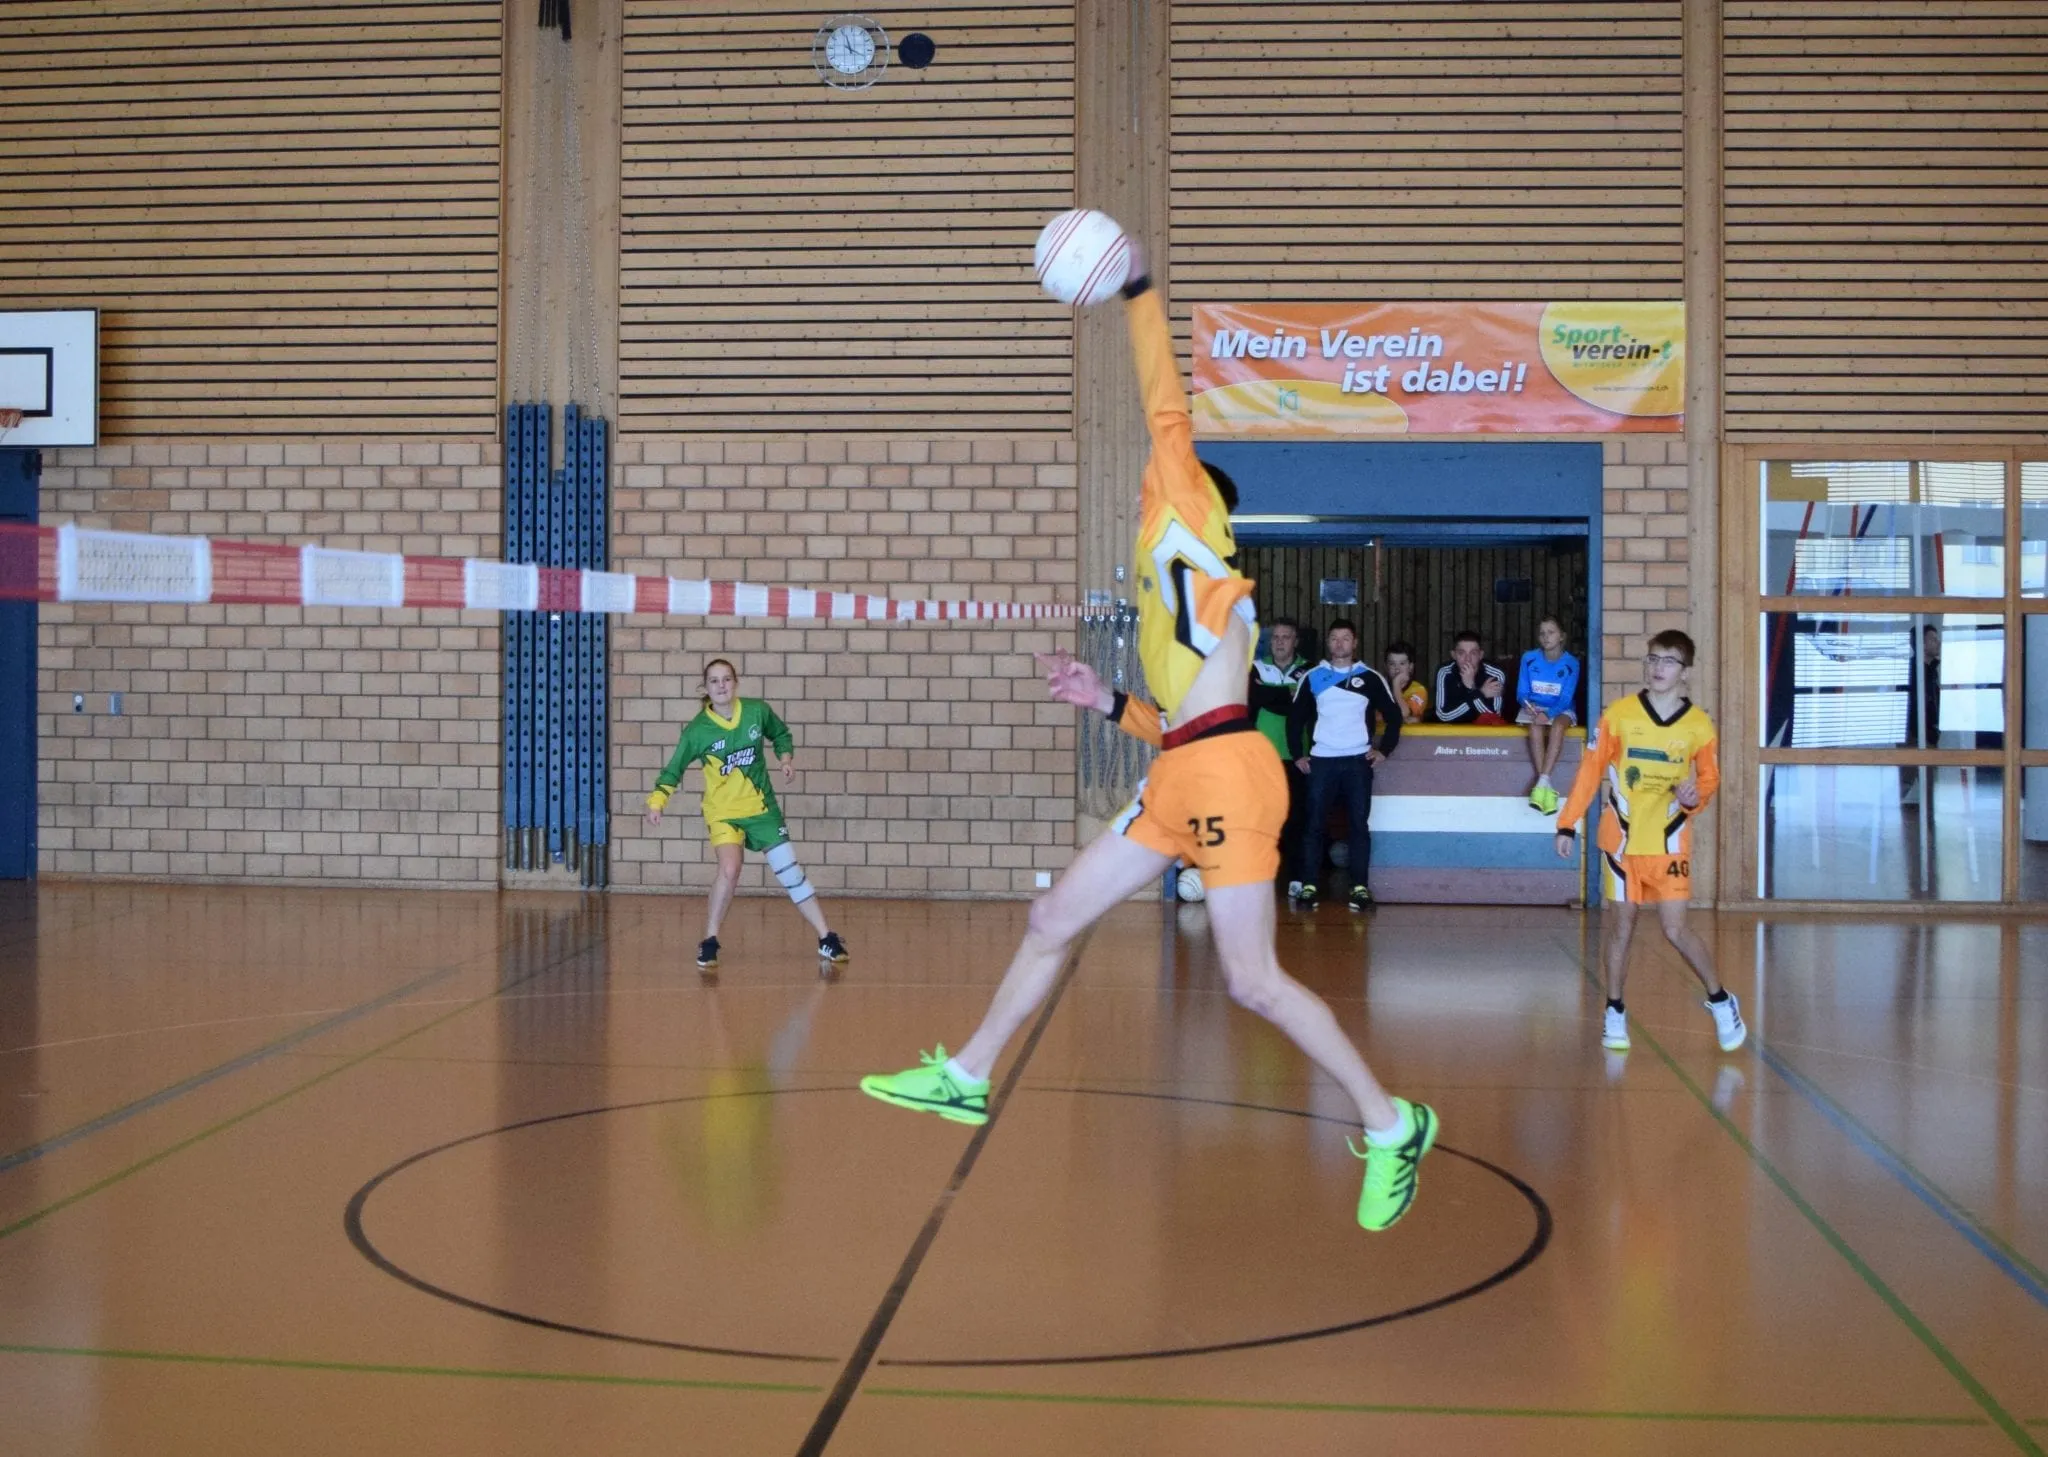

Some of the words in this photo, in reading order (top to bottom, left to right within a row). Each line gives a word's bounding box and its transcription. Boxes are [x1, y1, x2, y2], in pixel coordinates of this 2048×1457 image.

[1211, 328, 1307, 358] Mein
[1320, 327, 1443, 358] Verein
[1552, 324, 1630, 349] Sport-
[1572, 339, 1672, 360] verein-t
[1341, 362, 1391, 393] ist
[1401, 361, 1528, 393] dabei!
